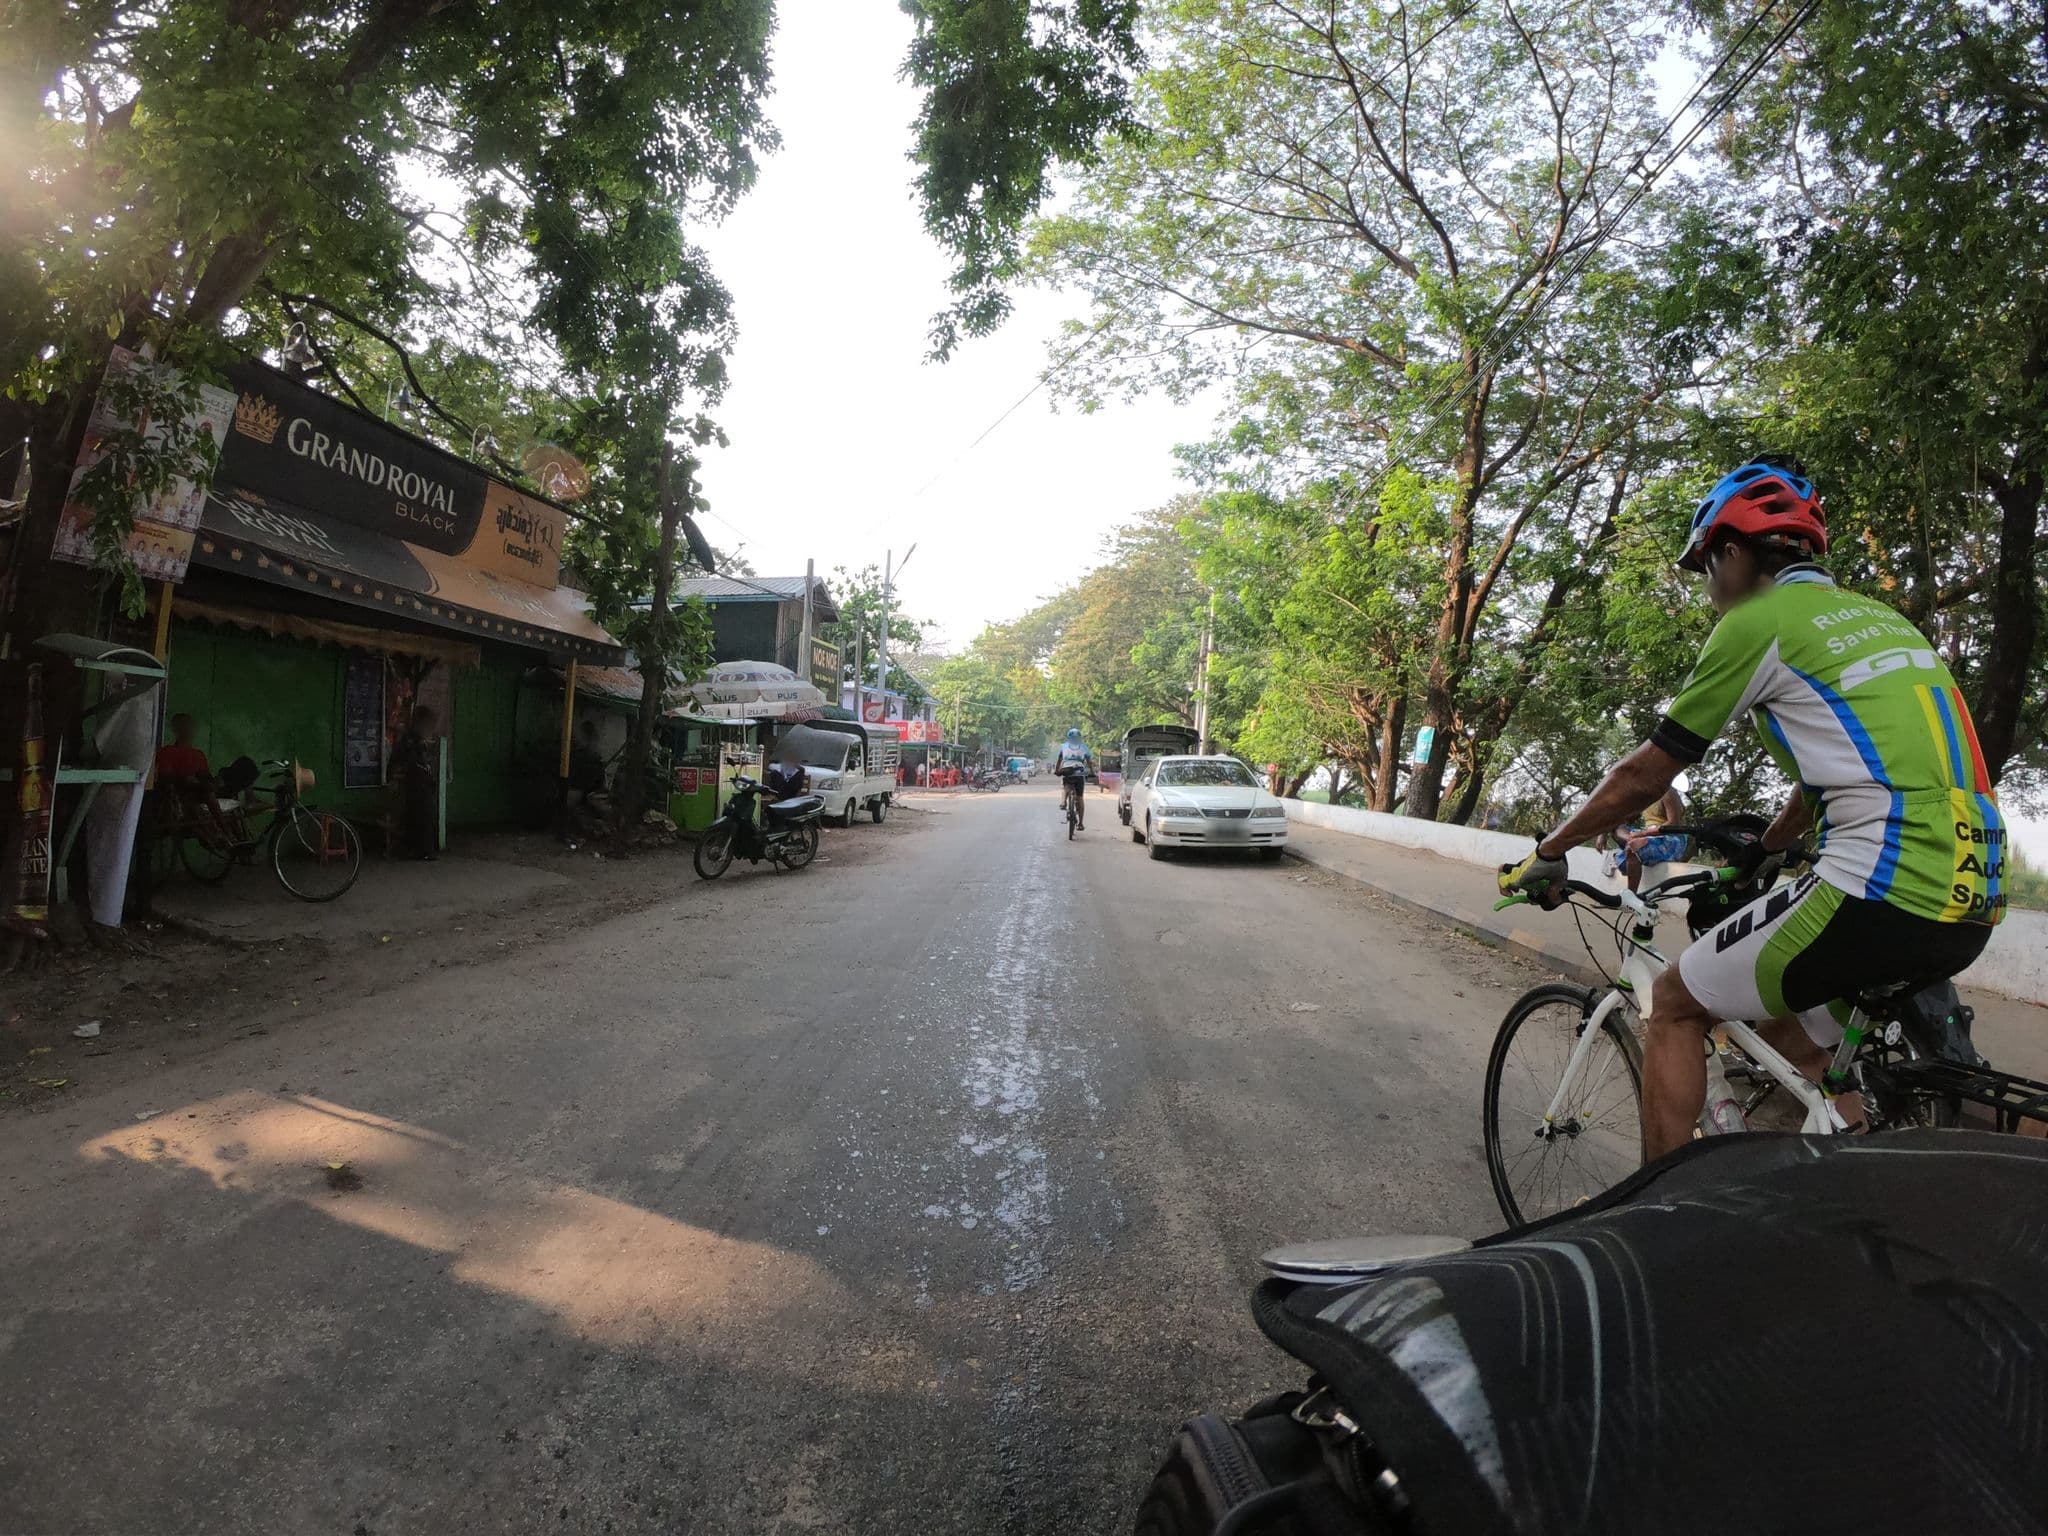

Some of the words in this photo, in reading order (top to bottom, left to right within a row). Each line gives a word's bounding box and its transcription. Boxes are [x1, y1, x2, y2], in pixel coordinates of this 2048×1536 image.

[287, 418, 458, 516] GRANDROYAL
[229, 508, 346, 556] ROYAL
[395, 501, 456, 536] BLACK
[1811, 606, 1863, 631] Ride
[1826, 625, 1881, 655] Save
[1879, 623, 1912, 637] The
[1840, 647, 1937, 692] GT
[712, 694, 738, 703] LUS
[778, 692, 798, 700] PLUS
